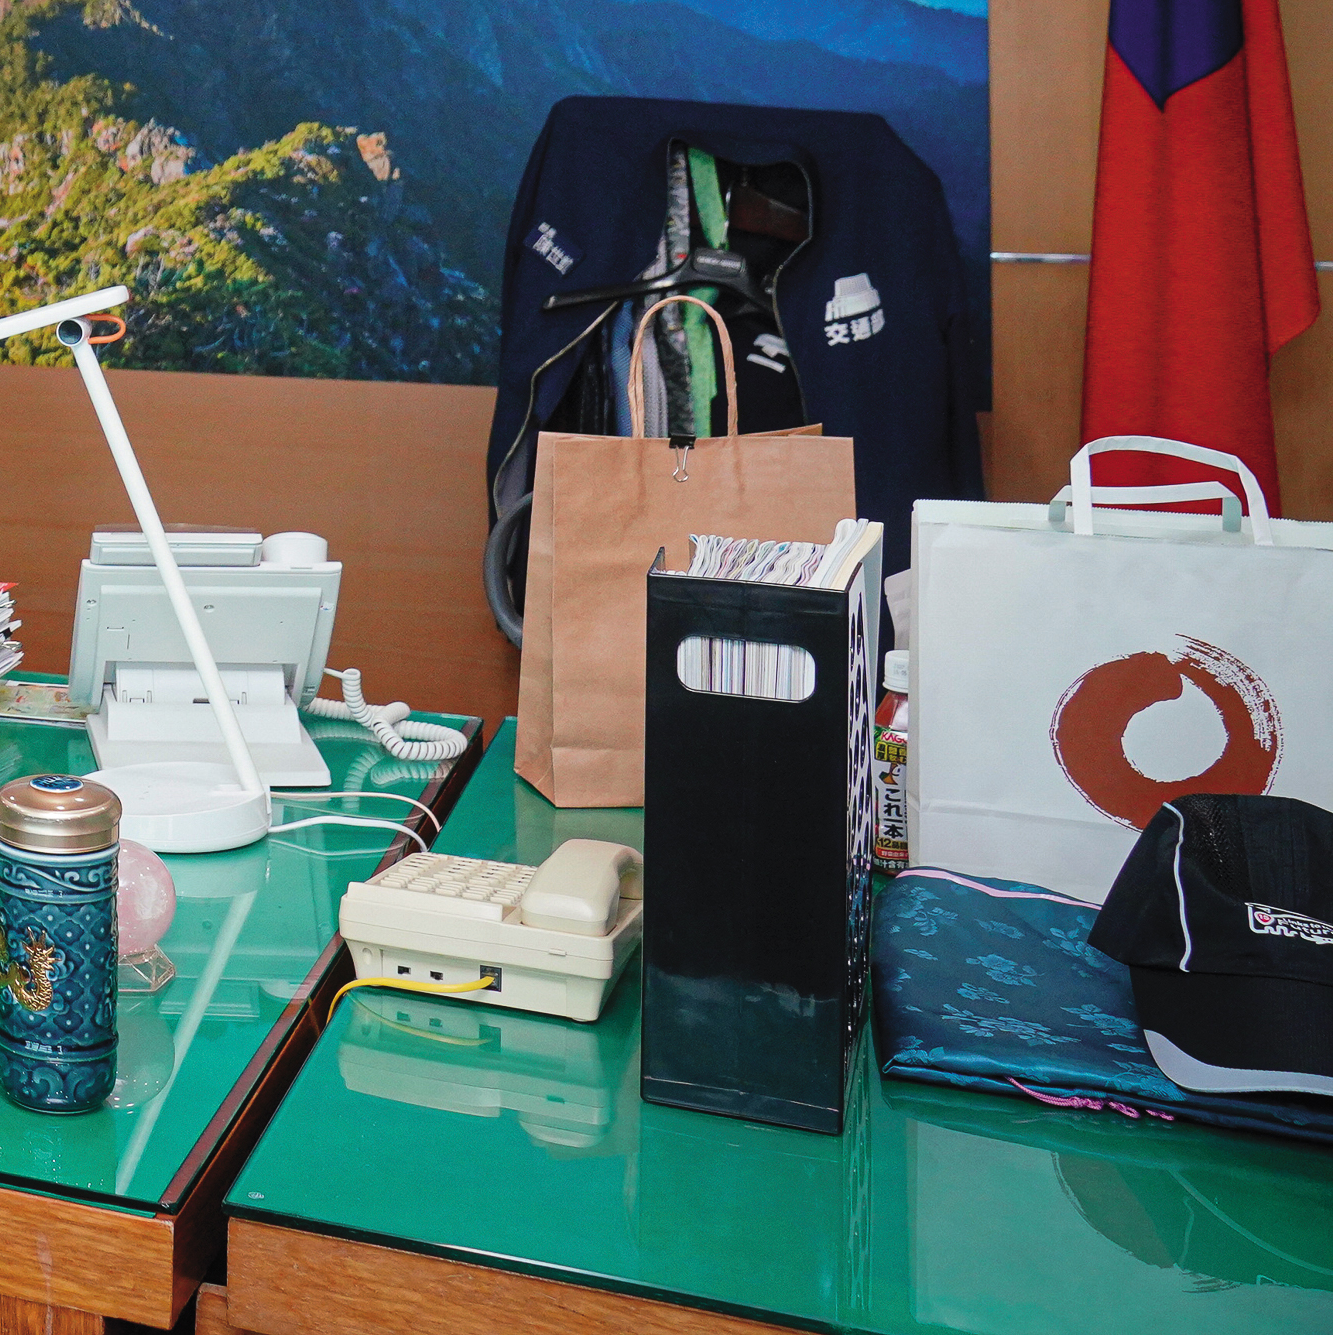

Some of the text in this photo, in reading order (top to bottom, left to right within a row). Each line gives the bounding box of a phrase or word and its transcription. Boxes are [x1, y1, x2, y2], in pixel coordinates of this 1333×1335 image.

[824, 309, 885, 346] 交通部
[883, 788, 904, 839] これ一本
